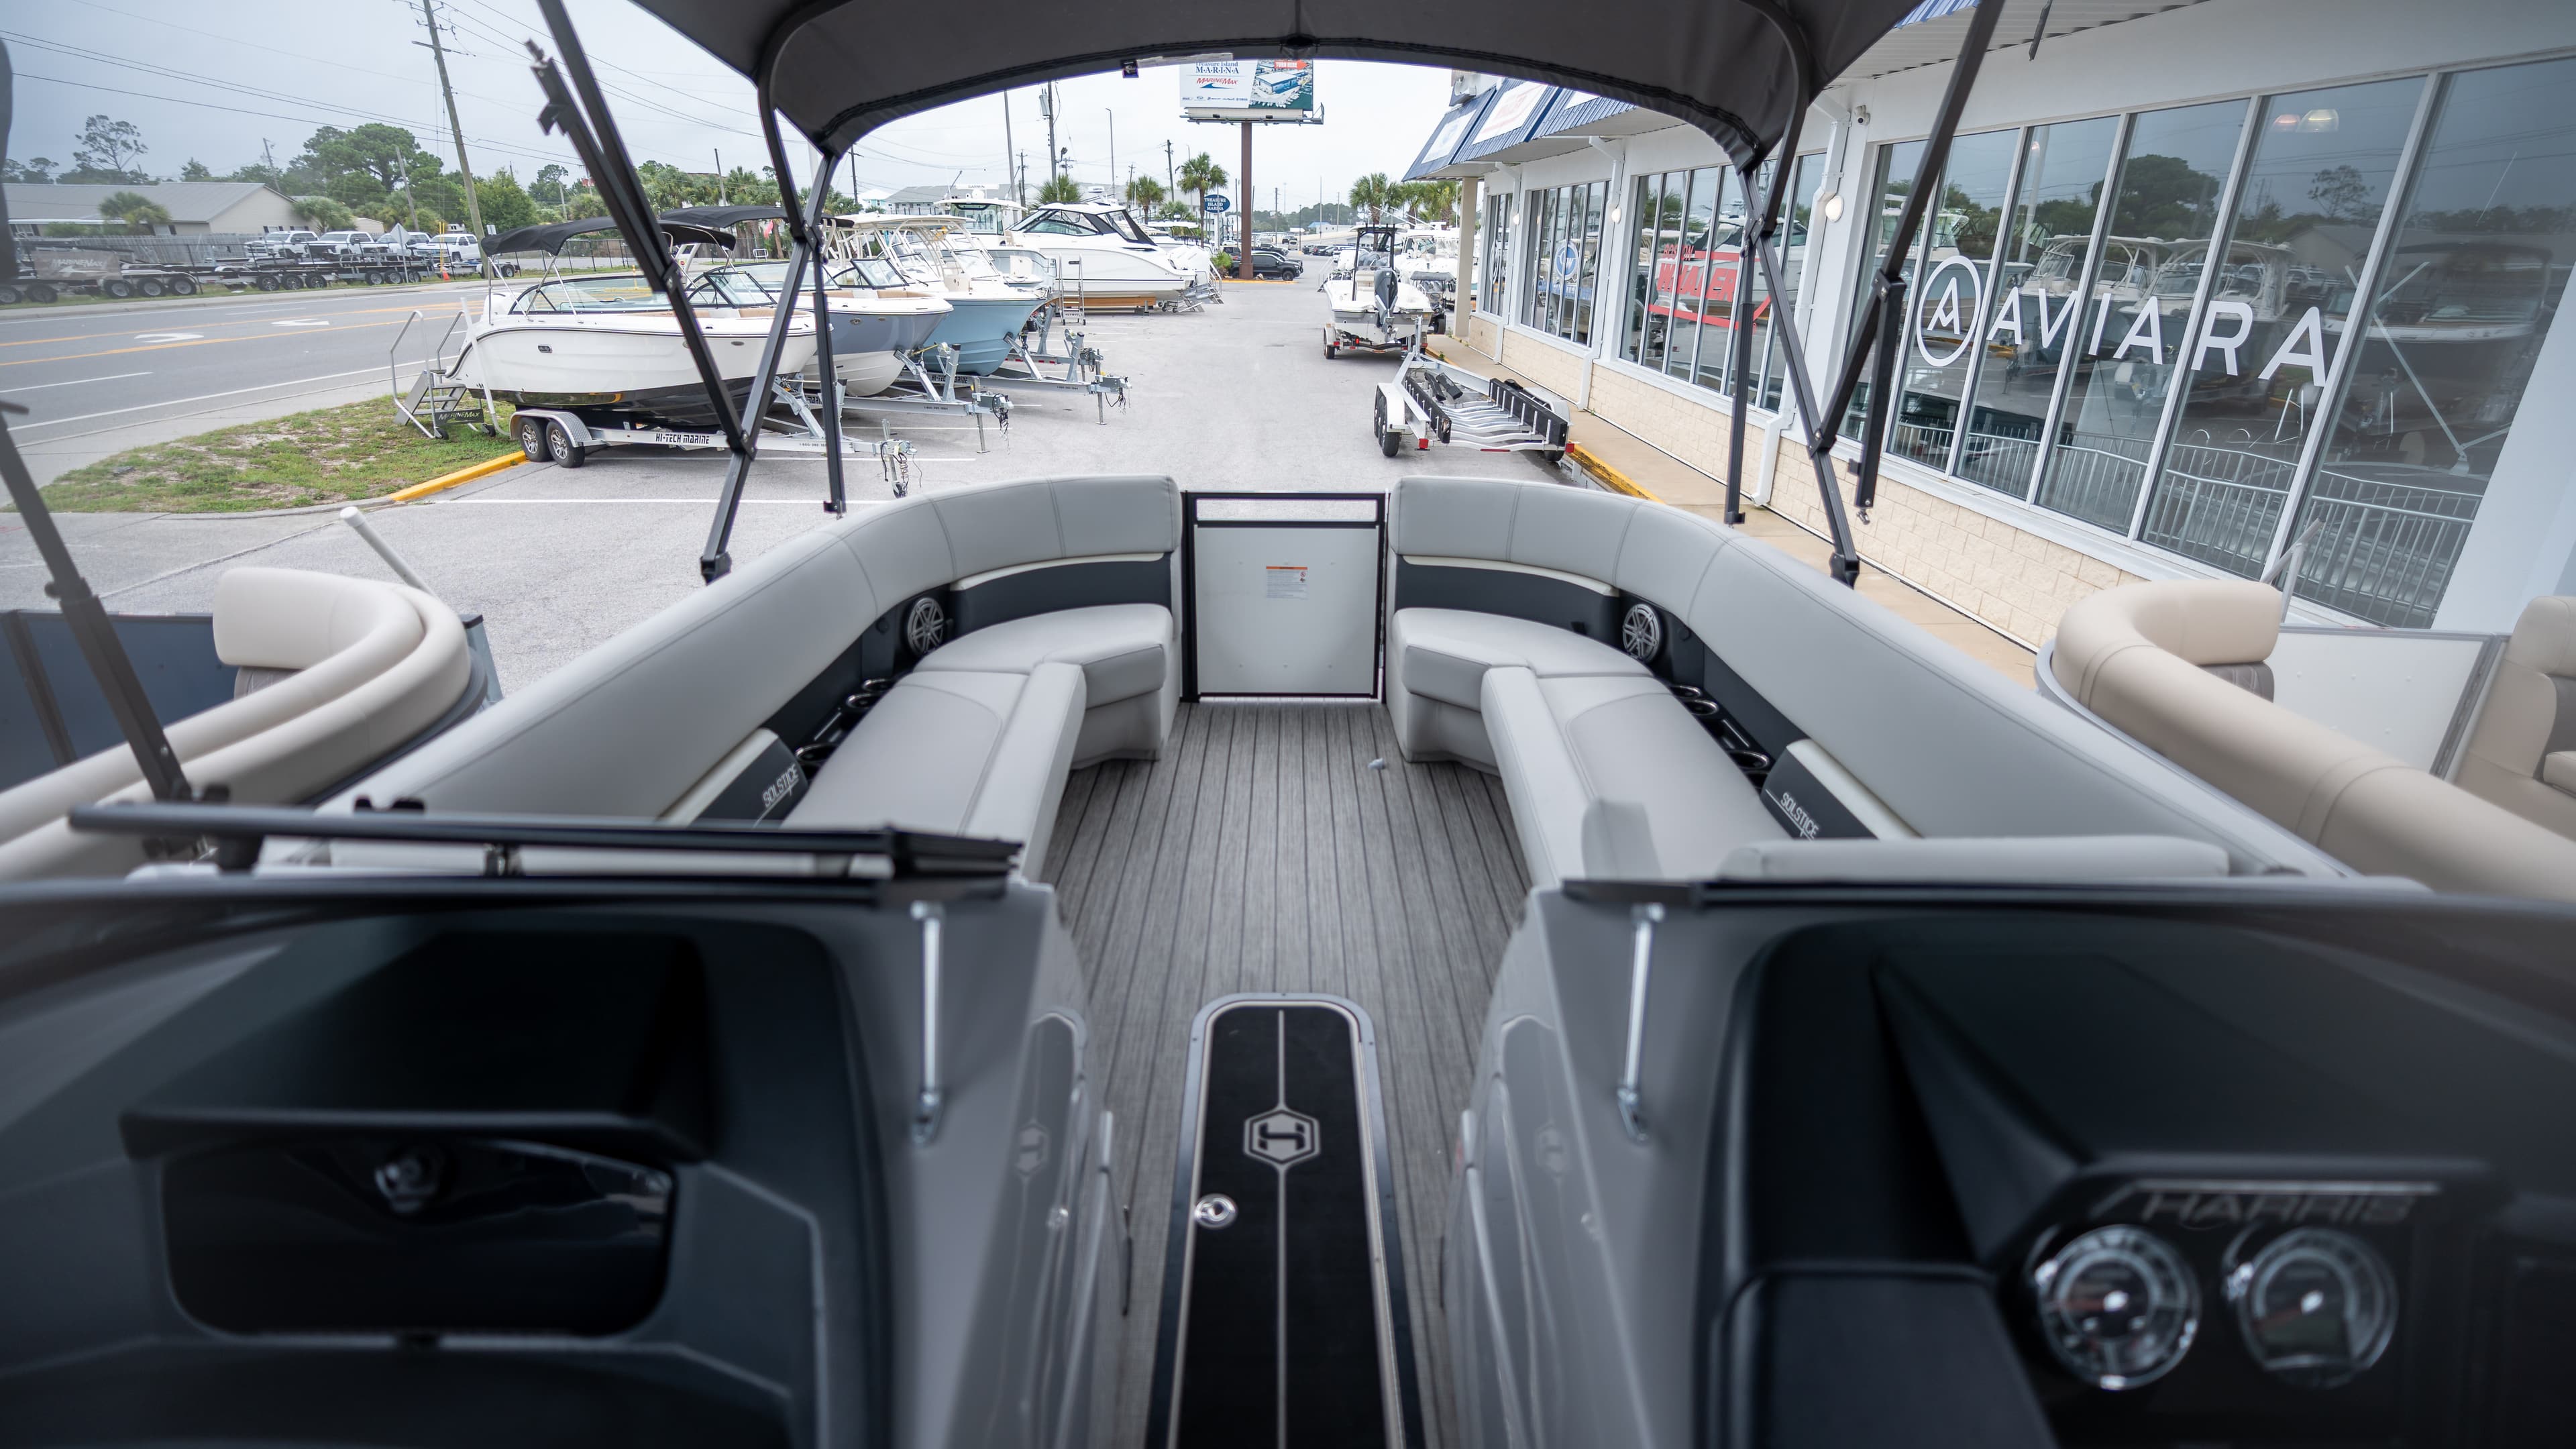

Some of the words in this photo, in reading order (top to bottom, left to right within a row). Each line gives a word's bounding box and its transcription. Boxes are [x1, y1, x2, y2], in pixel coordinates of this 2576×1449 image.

[1663, 243, 1695, 261] BOSON
[1986, 286, 2326, 388] AVIARA
[655, 433, 682, 443] HI-TECH
[683, 434, 710, 444] MARINE
[763, 763, 799, 809] SOLSTICE
[1780, 792, 1819, 839] SOLSTICE
